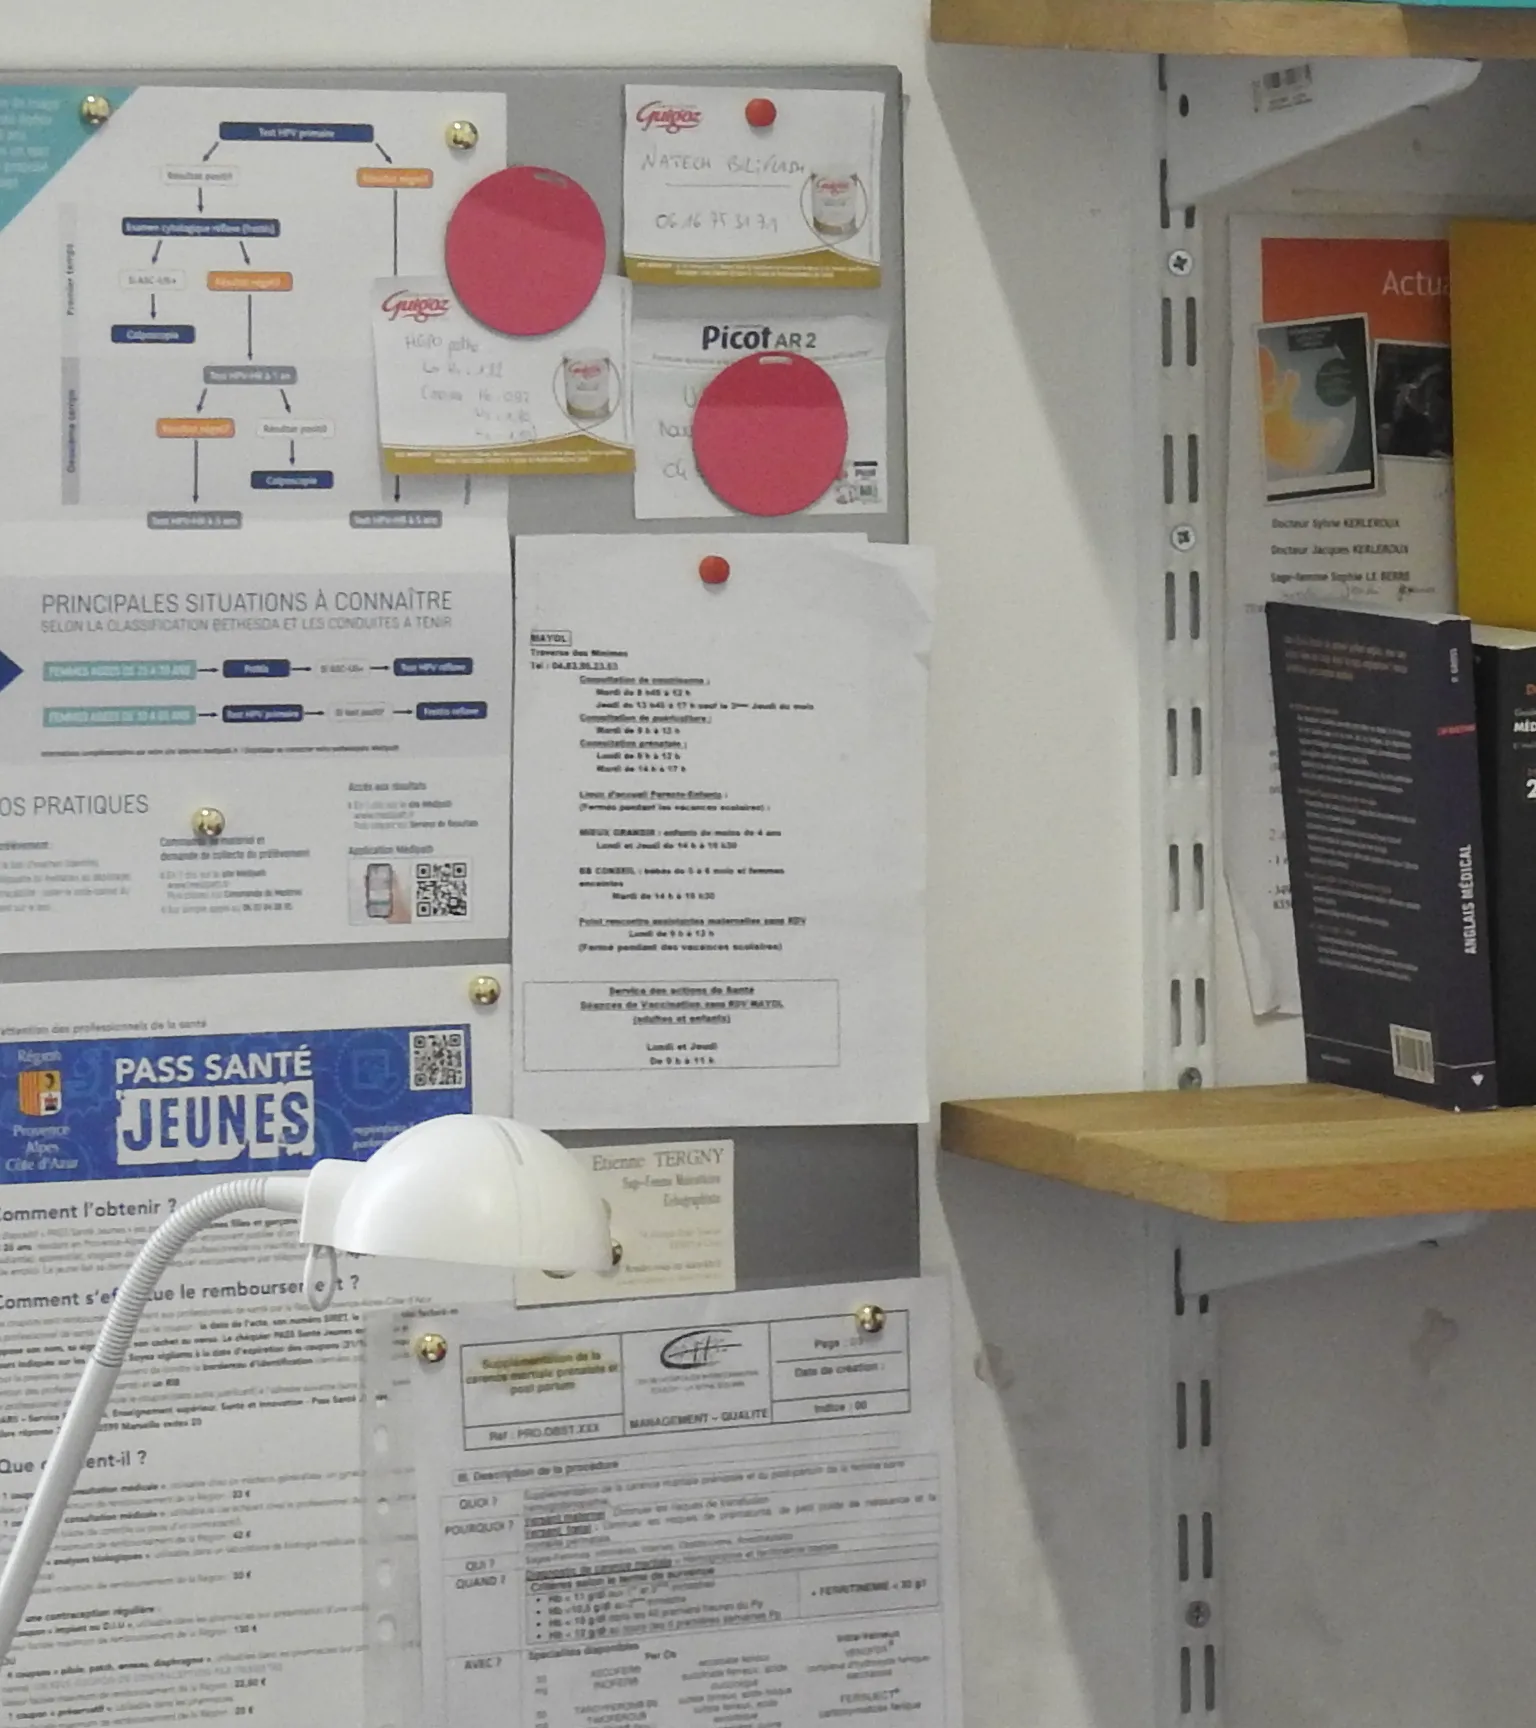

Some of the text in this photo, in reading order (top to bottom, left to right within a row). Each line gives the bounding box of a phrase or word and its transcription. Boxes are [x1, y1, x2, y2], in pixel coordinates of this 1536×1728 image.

[1381, 270, 1450, 296] Actu
[702, 325, 817, 350] Picot AR 2
[42, 587, 452, 615] PRINCIPALES SITUATIONS À CONNAÎTRE
[33, 794, 149, 815] PRATIQUES
[1459, 843, 1478, 955] ANGLAIS MÉDICAL
[73, 1021, 148, 1035] professionnels
[116, 1044, 313, 1085] PASS SANTÉ
[122, 1091, 310, 1151] JEUNES
[653, 1148, 724, 1168] TERGNY
[0, 1205, 78, 1222] omment
[84, 1201, 161, 1219] l'obtenir
[180, 1283, 196, 1299] le
[351, 1274, 360, 1290] ?
[0, 1458, 35, 1474] Que
[137, 1450, 147, 1465] ?
